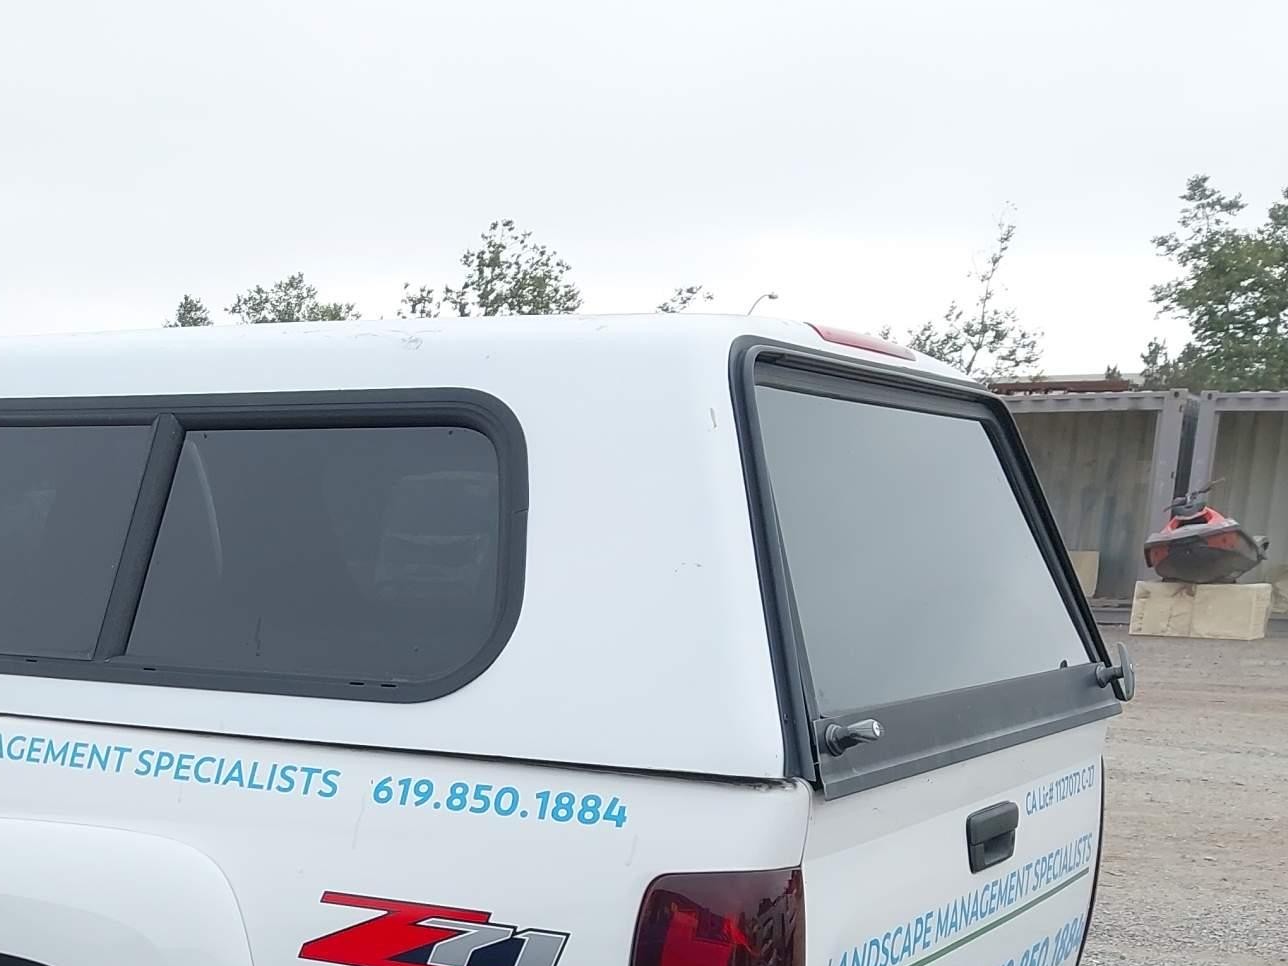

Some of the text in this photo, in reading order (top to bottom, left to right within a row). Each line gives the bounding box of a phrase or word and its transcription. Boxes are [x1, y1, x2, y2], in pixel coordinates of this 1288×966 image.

[134, 749, 342, 798] SPECIALISTS
[371, 775, 628, 828] 619.850.1884
[1025, 764, 1095, 816] CA Lic# 1127072 C-27
[934, 863, 1033, 944] MANAGEMENT
[1031, 832, 1094, 892] SPECIALISTS
